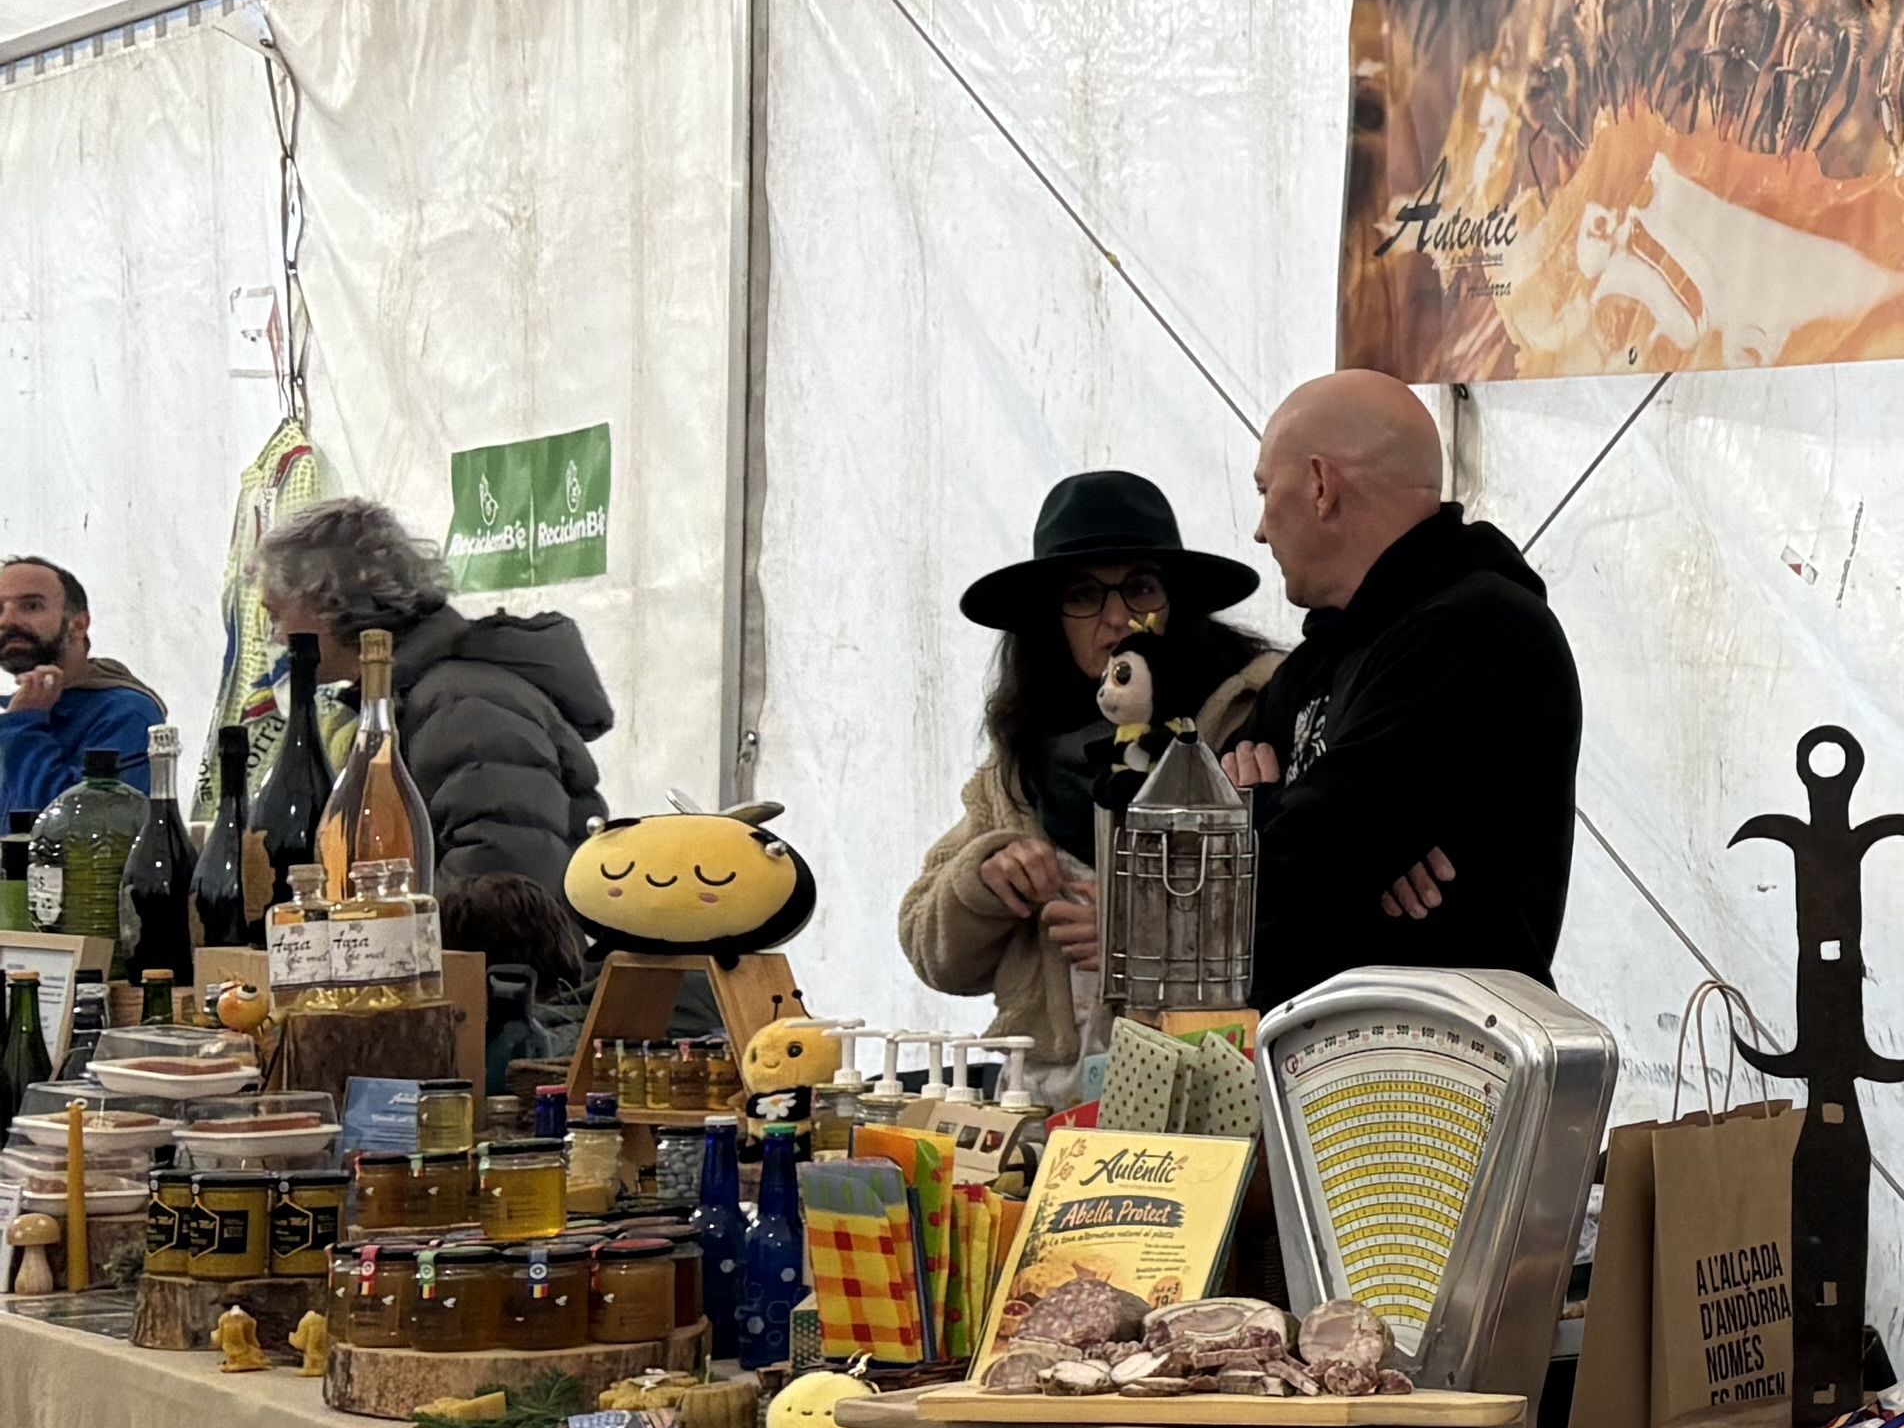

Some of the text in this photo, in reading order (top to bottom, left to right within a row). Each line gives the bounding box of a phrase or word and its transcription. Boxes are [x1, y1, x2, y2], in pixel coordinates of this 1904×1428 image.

[1059, 1199, 1172, 1228] Abella Protect
[1696, 1241, 1784, 1297] A L'ALÇADA
[1700, 1283, 1792, 1341] D'ANDORRA
[1705, 1330, 1765, 1384] NOMÉS
